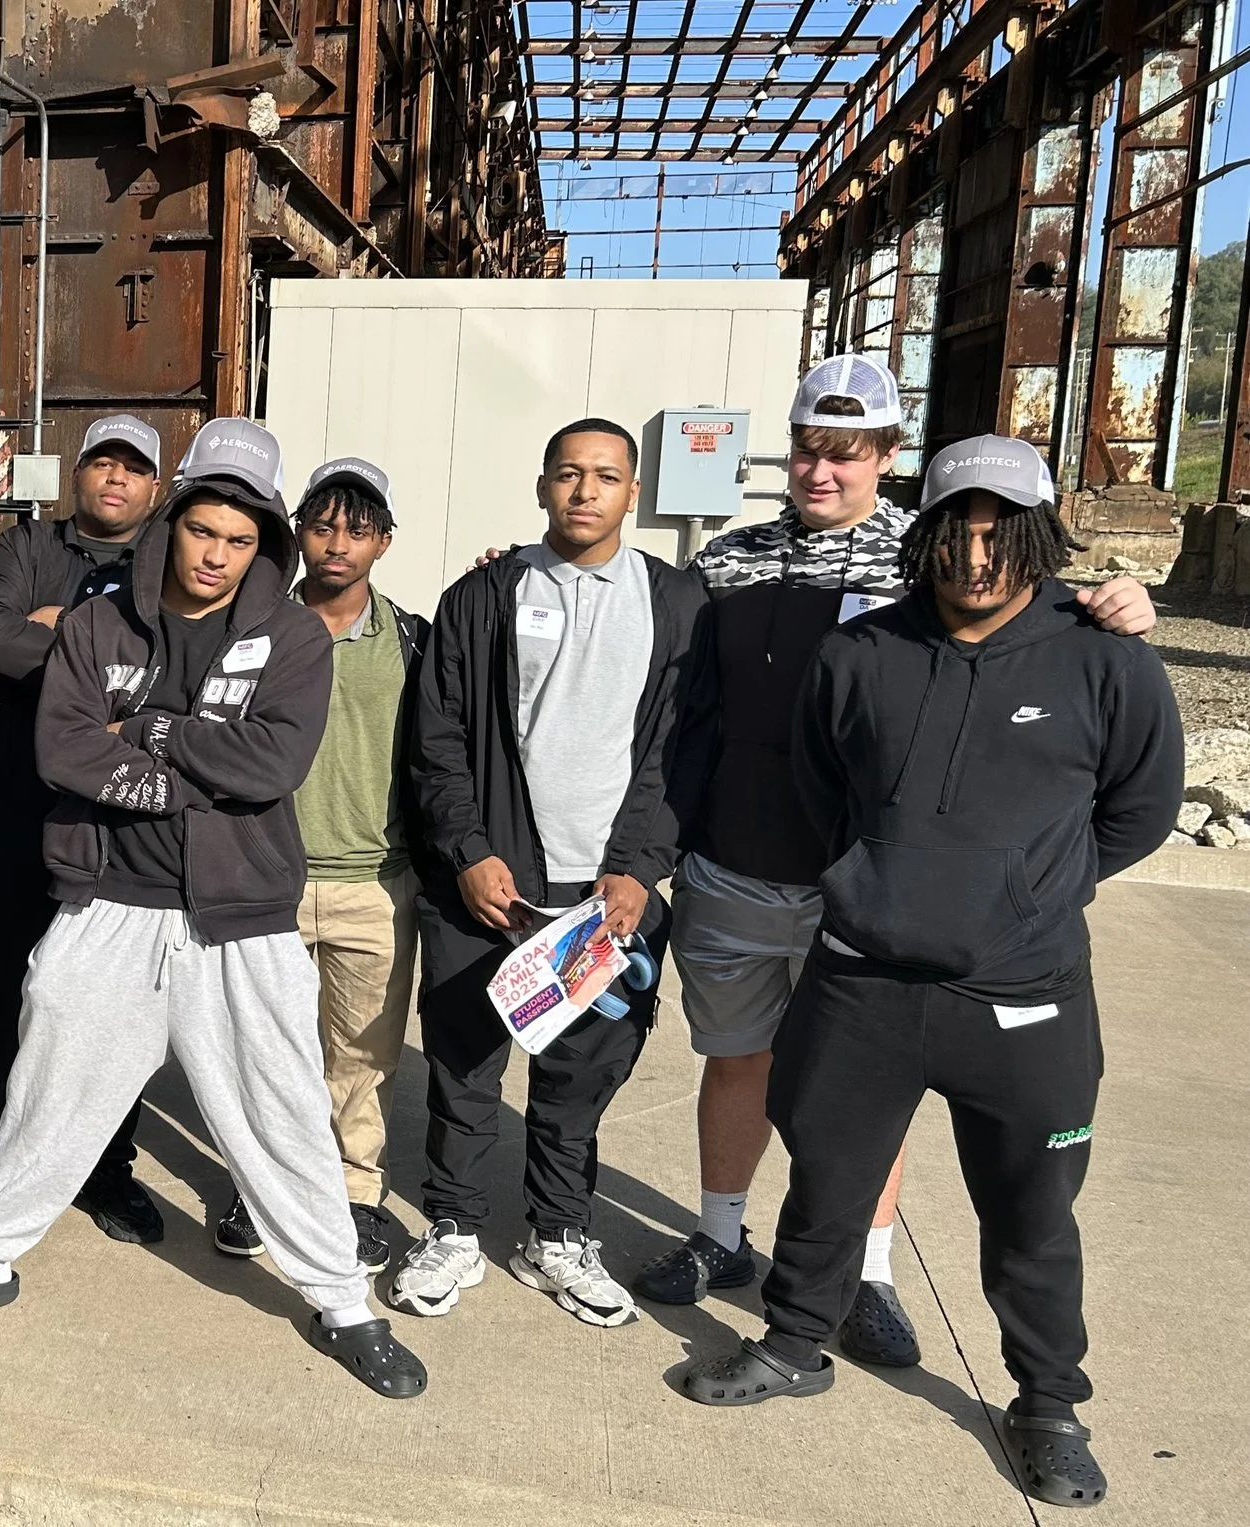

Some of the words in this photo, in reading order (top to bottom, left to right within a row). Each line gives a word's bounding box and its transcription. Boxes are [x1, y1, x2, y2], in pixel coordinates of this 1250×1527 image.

[108, 423, 149, 441] AEROTECH
[688, 424, 726, 433] DANGER
[221, 438, 269, 461] AEROTECH
[333, 464, 378, 481] AEROTECH
[957, 456, 1021, 469] AEROTECH
[1018, 706, 1043, 717] NIKE
[489, 961, 521, 989] MFG
[522, 937, 549, 966] DAY
[495, 984, 507, 997] @
[510, 961, 543, 988] MILL
[500, 976, 539, 1009] 2025
[513, 986, 555, 1019] STUDENT
[516, 993, 560, 1028] PASSPORT
